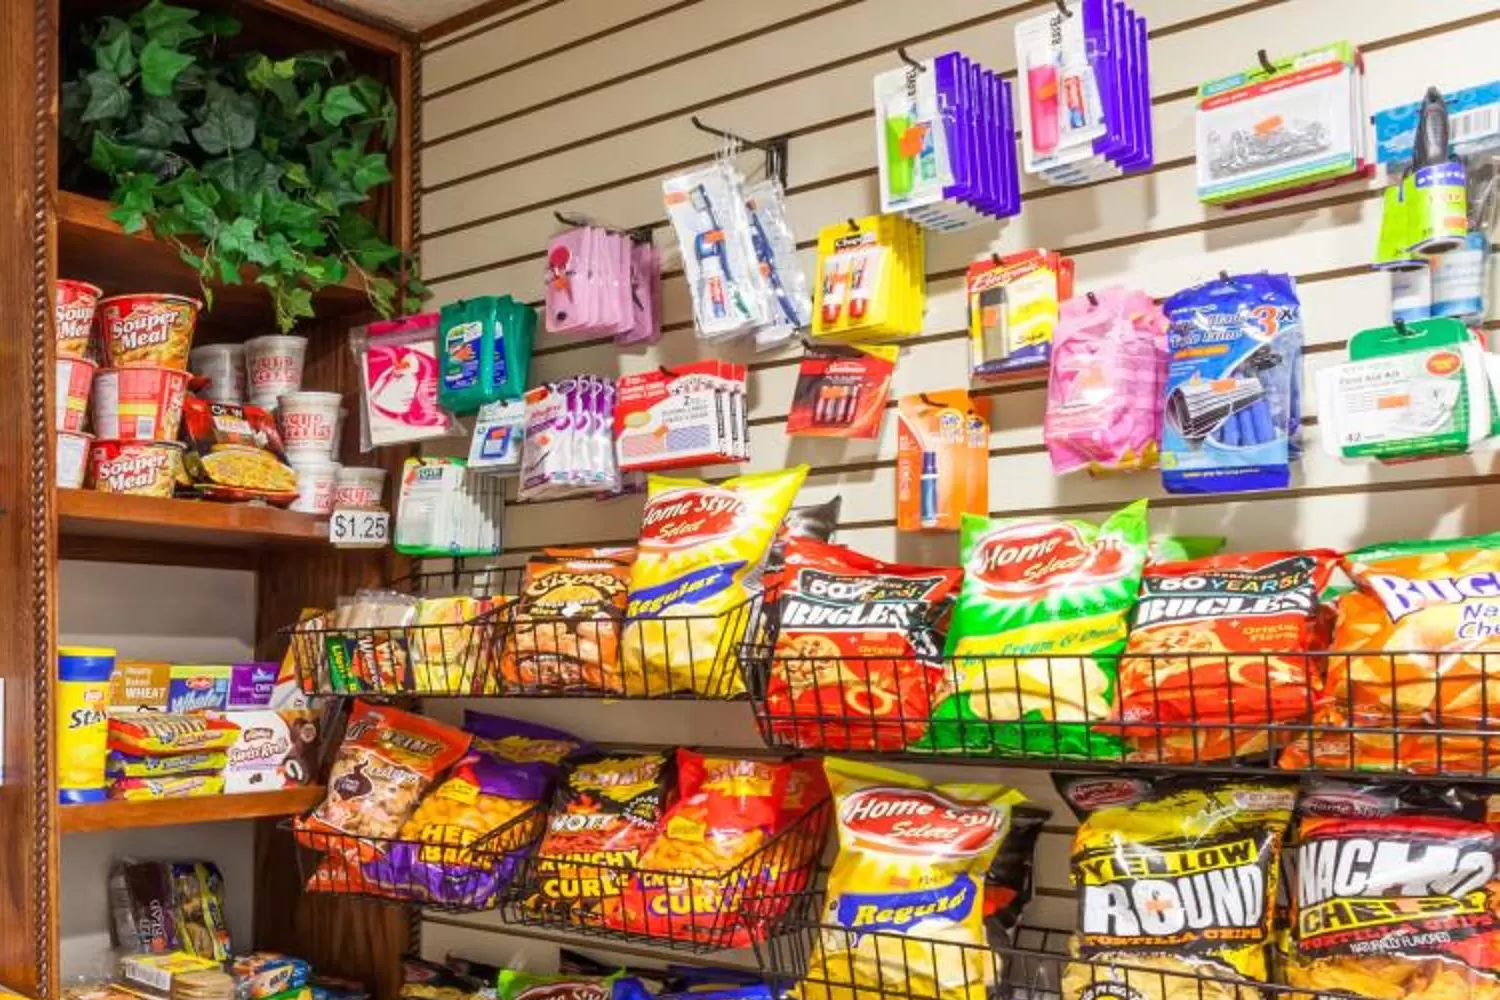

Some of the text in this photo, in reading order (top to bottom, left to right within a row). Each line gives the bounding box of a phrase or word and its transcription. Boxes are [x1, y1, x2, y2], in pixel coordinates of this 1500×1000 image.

[56, 306, 93, 322] Soup
[112, 311, 179, 338] Souper
[121, 328, 168, 350] Meal
[99, 454, 169, 480] Souper
[110, 472, 156, 492] Meal
[694, 495, 740, 518] Styl
[334, 513, 387, 539] $1.25
[847, 798, 935, 826] Home
[540, 850, 642, 873] RUNCHY
[1082, 839, 1250, 880] YELLOW
[1299, 838, 1495, 908] NACHO
[853, 887, 968, 927] Regular
[1083, 864, 1264, 936] ROUND
